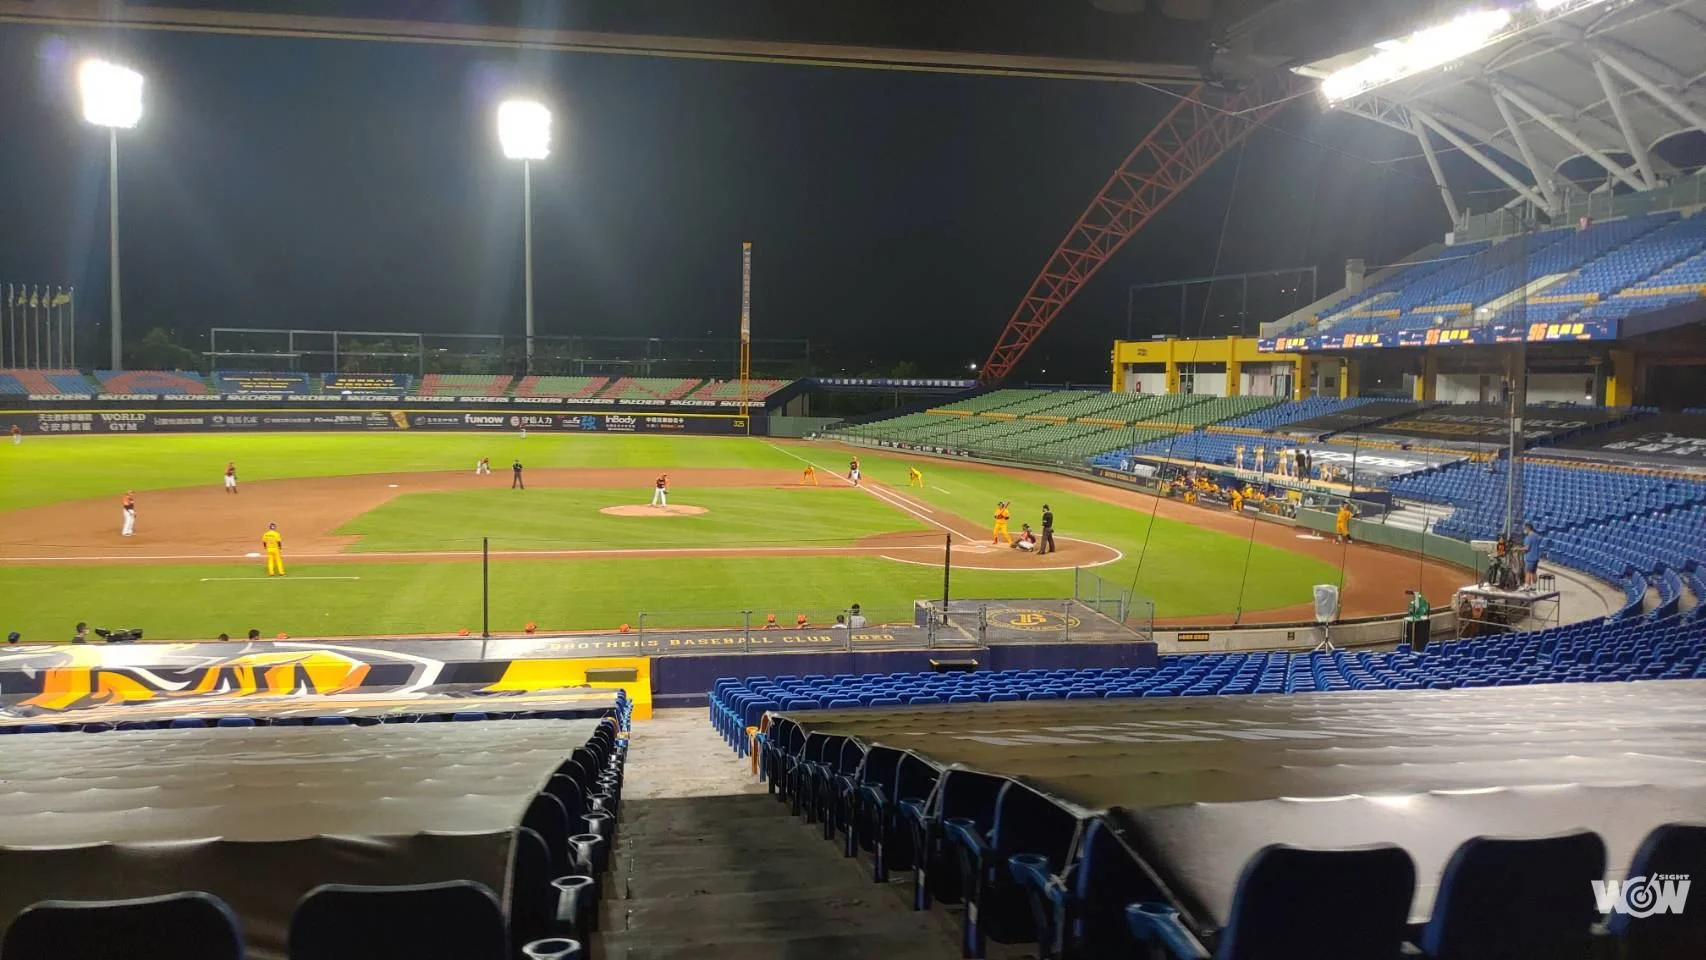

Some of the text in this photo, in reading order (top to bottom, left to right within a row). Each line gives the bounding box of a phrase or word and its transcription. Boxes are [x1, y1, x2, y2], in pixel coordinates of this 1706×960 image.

[101, 413, 146, 421] WORLD
[605, 415, 636, 425] InBody
[109, 423, 138, 431] GYM
[549, 640, 658, 649] BROTHERS
[670, 637, 774, 646] BASEBALL
